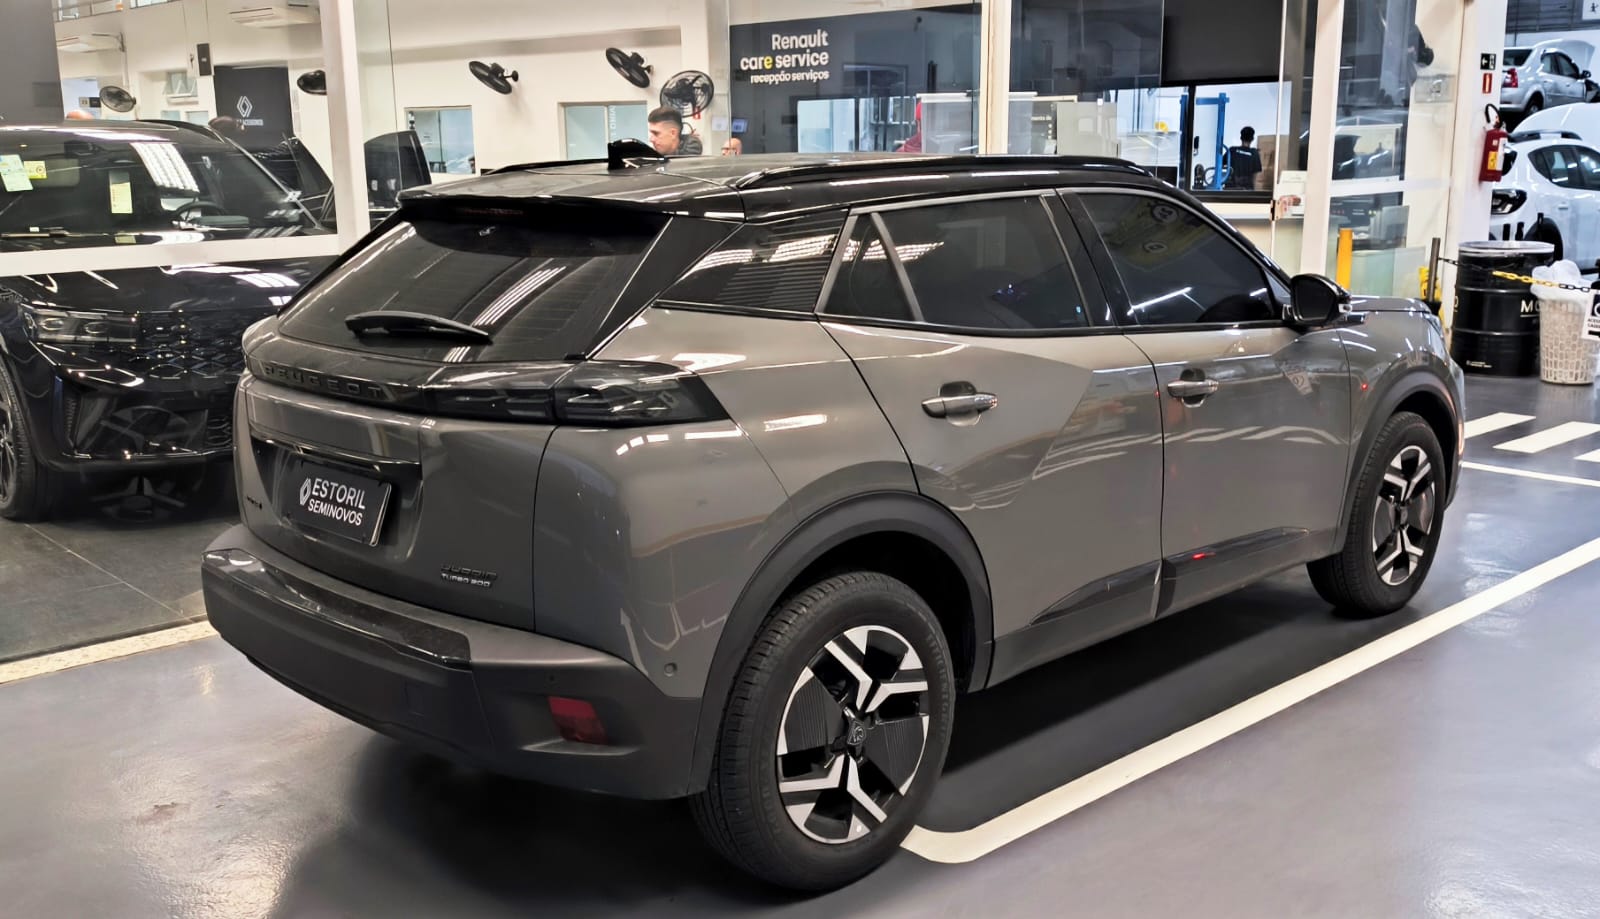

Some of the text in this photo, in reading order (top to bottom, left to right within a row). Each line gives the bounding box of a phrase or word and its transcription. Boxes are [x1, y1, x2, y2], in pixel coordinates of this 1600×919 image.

[771, 29, 829, 50] Renault
[740, 48, 829, 70] care service
[750, 69, 830, 85] recepção serviços
[263, 364, 382, 398] PEUGEOT
[311, 477, 366, 510] ESTORIL
[307, 498, 363, 526] SEMINOVOS
[471, 579, 491, 588] 200
